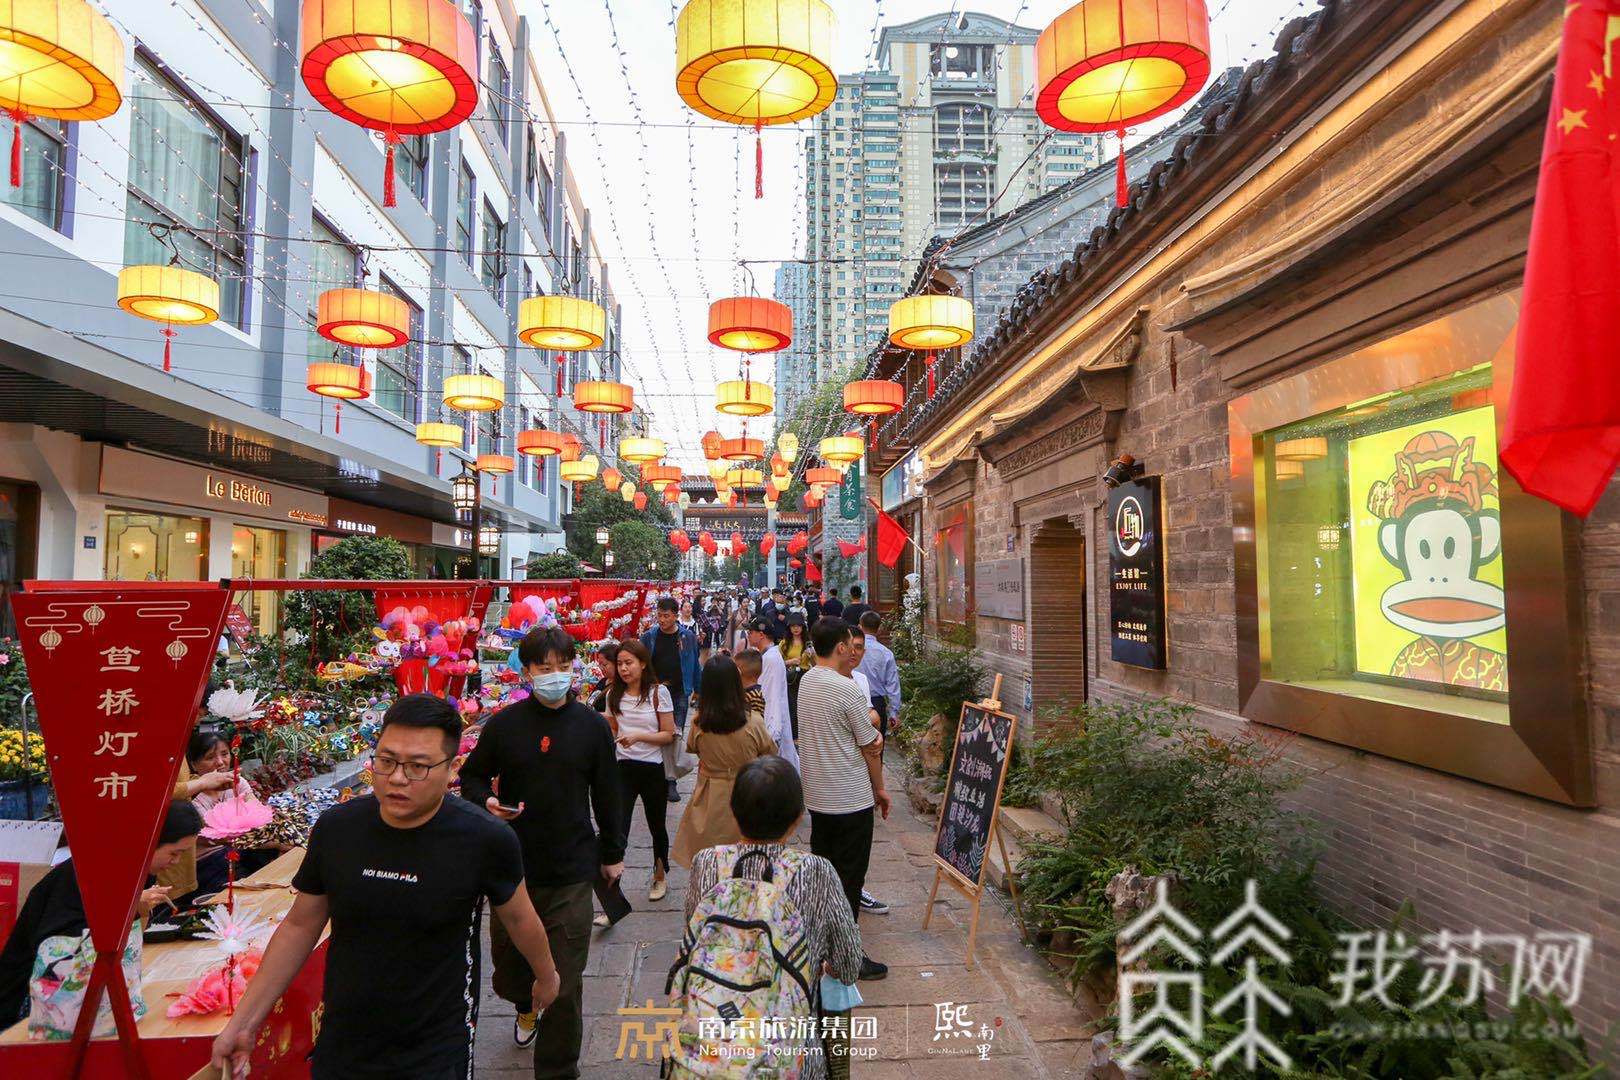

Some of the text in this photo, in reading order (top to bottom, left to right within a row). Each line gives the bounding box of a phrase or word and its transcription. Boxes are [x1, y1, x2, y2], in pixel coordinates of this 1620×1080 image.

[207, 474, 225, 497] Le
[1115, 582, 1148, 590] ENJOY LIFE
[94, 645, 141, 800] 笪桥灯市
[362, 868, 418, 883] NOI SIAMO FILA
